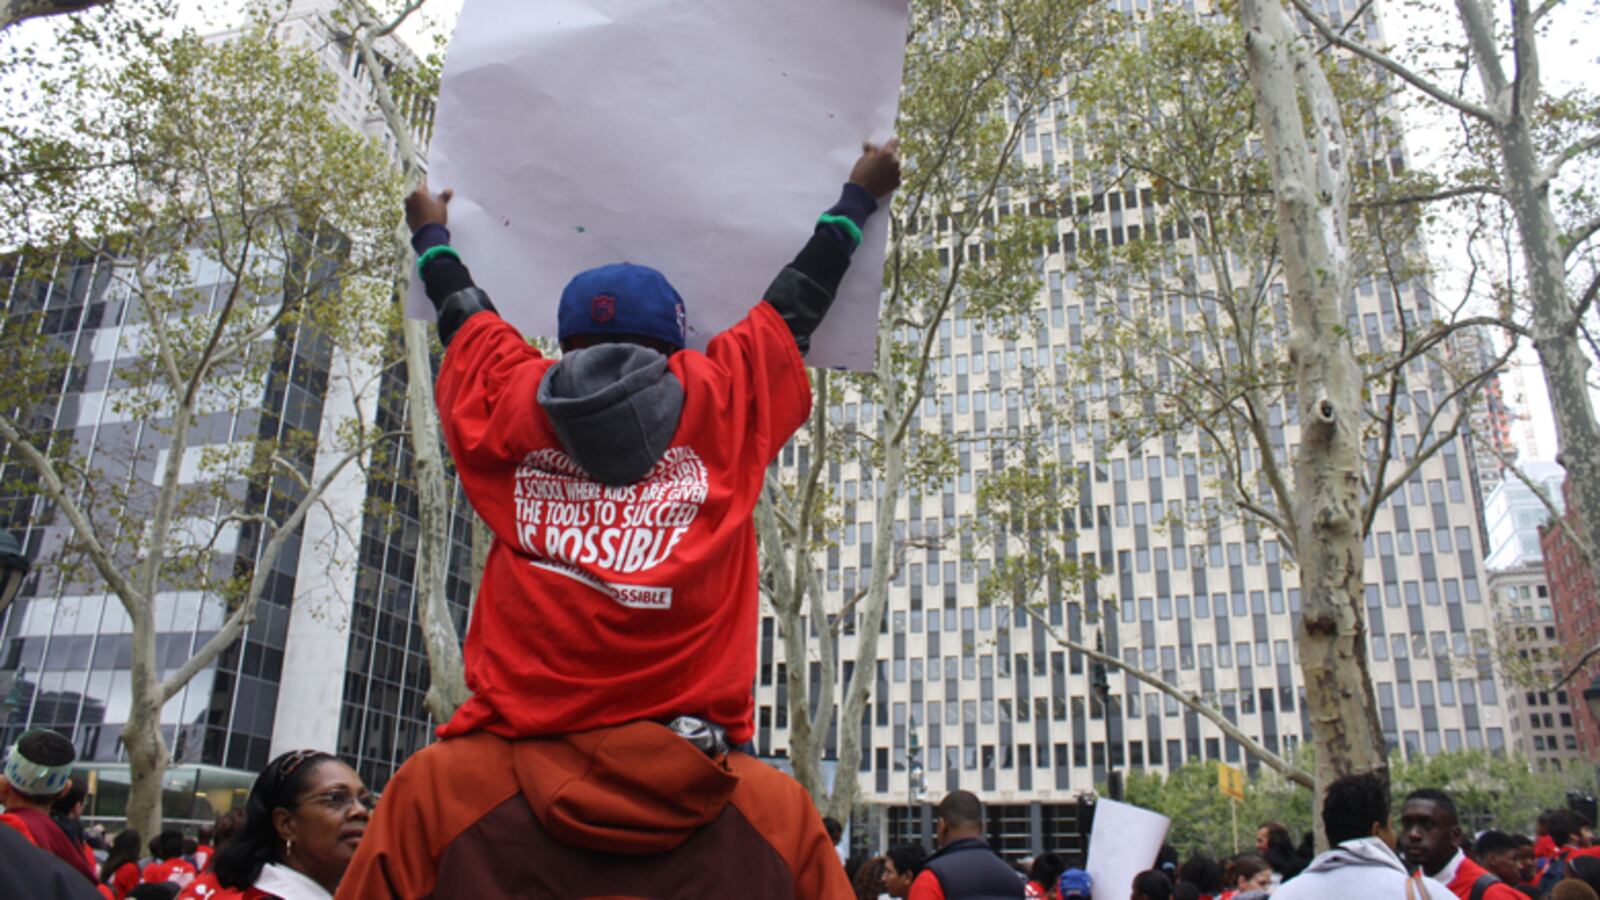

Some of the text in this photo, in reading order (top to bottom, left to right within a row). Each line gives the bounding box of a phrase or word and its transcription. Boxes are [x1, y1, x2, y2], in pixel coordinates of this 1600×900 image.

[514, 479, 709, 504] A SCHOOL WHERE KIDS ARE GIVEN
[514, 498, 699, 528] THE TOOLS TO SUCCEED
[545, 526, 689, 574] POSSIBLE
